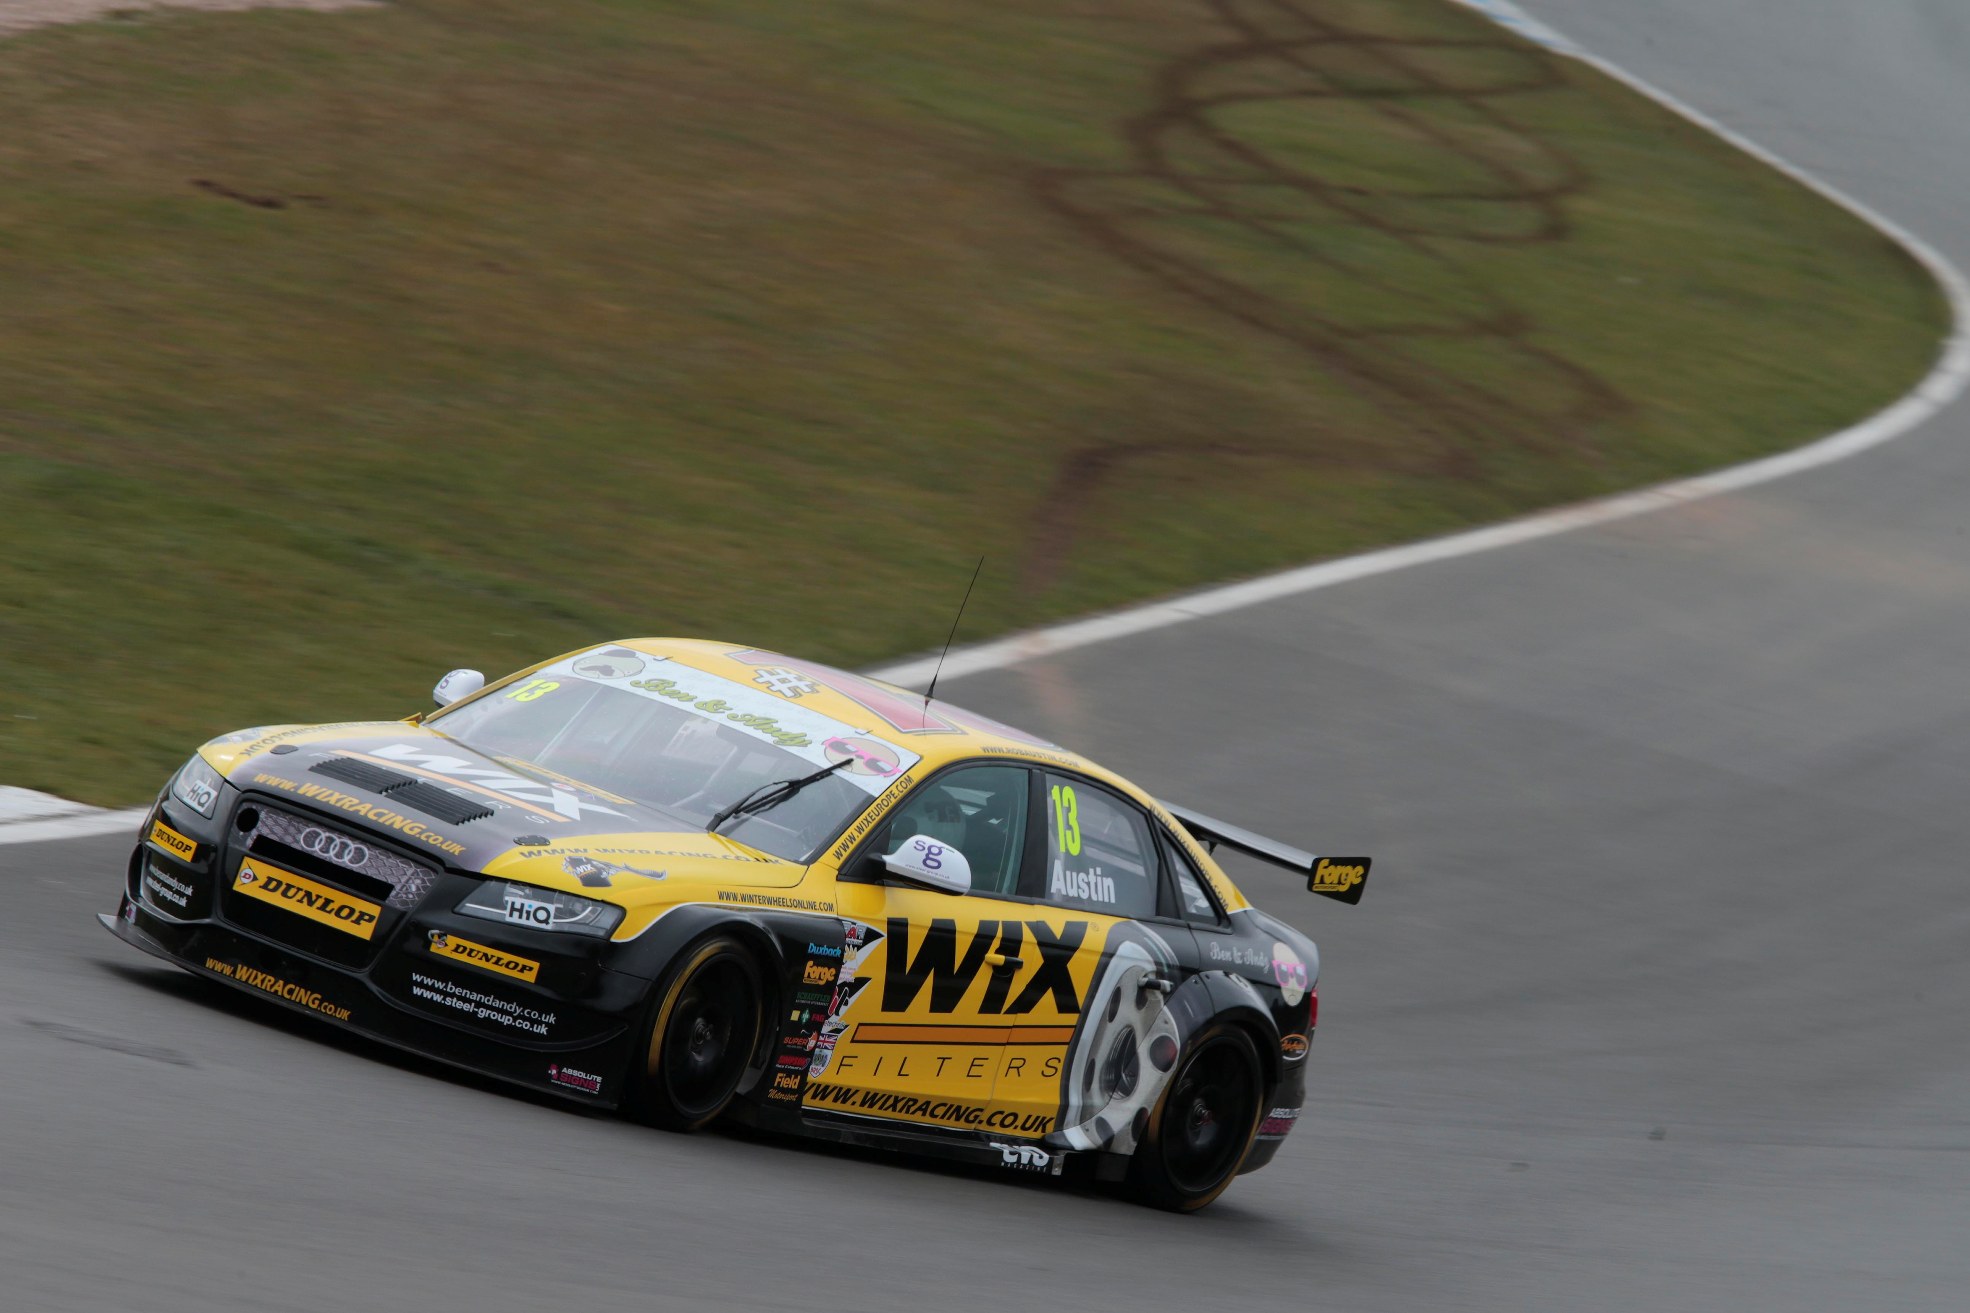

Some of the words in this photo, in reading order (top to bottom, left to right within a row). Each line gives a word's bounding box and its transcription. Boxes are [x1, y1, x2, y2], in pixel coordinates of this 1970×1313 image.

[506, 678, 560, 703] 13
[630, 678, 698, 703] Ben
[694, 698, 732, 714] &
[726, 711, 812, 748] Andy
[186, 783, 211, 808] HiQ
[832, 775, 914, 861] WWW.WIXEUROPE.COM
[1051, 785, 1081, 856] 13
[156, 828, 192, 853] DUNLOP
[1050, 860, 1116, 904] Austin
[258, 874, 376, 927] DUNLOP
[718, 890, 835, 913] WWW.WINTERWHEELSONLINE.COM
[508, 901, 552, 926] HiQ
[451, 943, 534, 975] DUNLOP
[808, 943, 841, 957] Duxback
[1210, 941, 1231, 961] Ben
[881, 917, 1089, 1015] WIX
[411, 971, 557, 1025] www.benandandy.co.uk
[412, 985, 549, 1036] www.steel-group.co.uk
[561, 1066, 603, 1083] ABSOLUTE
[835, 1055, 1062, 1078] FILTERS
[559, 1073, 597, 1091] SIGNS
[774, 1072, 800, 1089] Field
